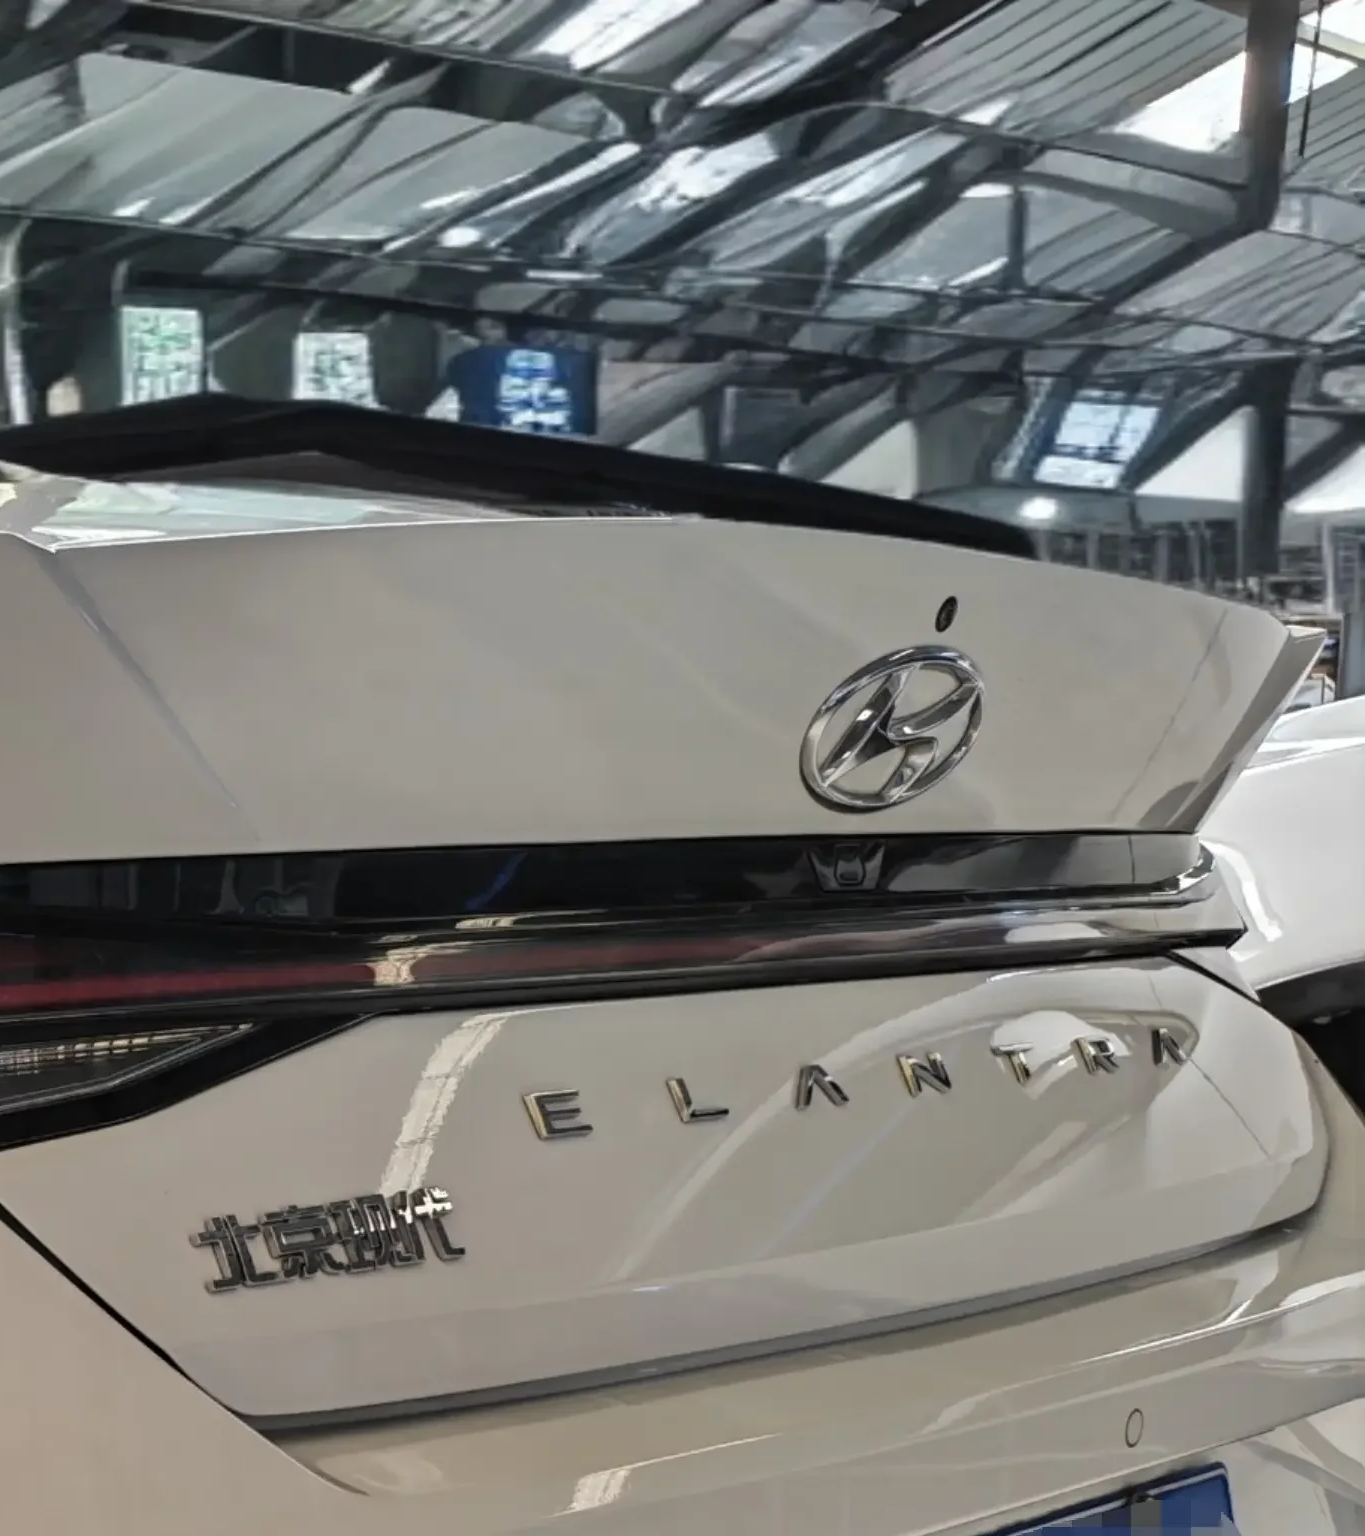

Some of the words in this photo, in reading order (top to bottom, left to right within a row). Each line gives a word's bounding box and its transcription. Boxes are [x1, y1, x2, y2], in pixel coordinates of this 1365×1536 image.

[523, 1027, 1192, 1140] ELANTRA
[189, 1185, 467, 1294] 北京现代
